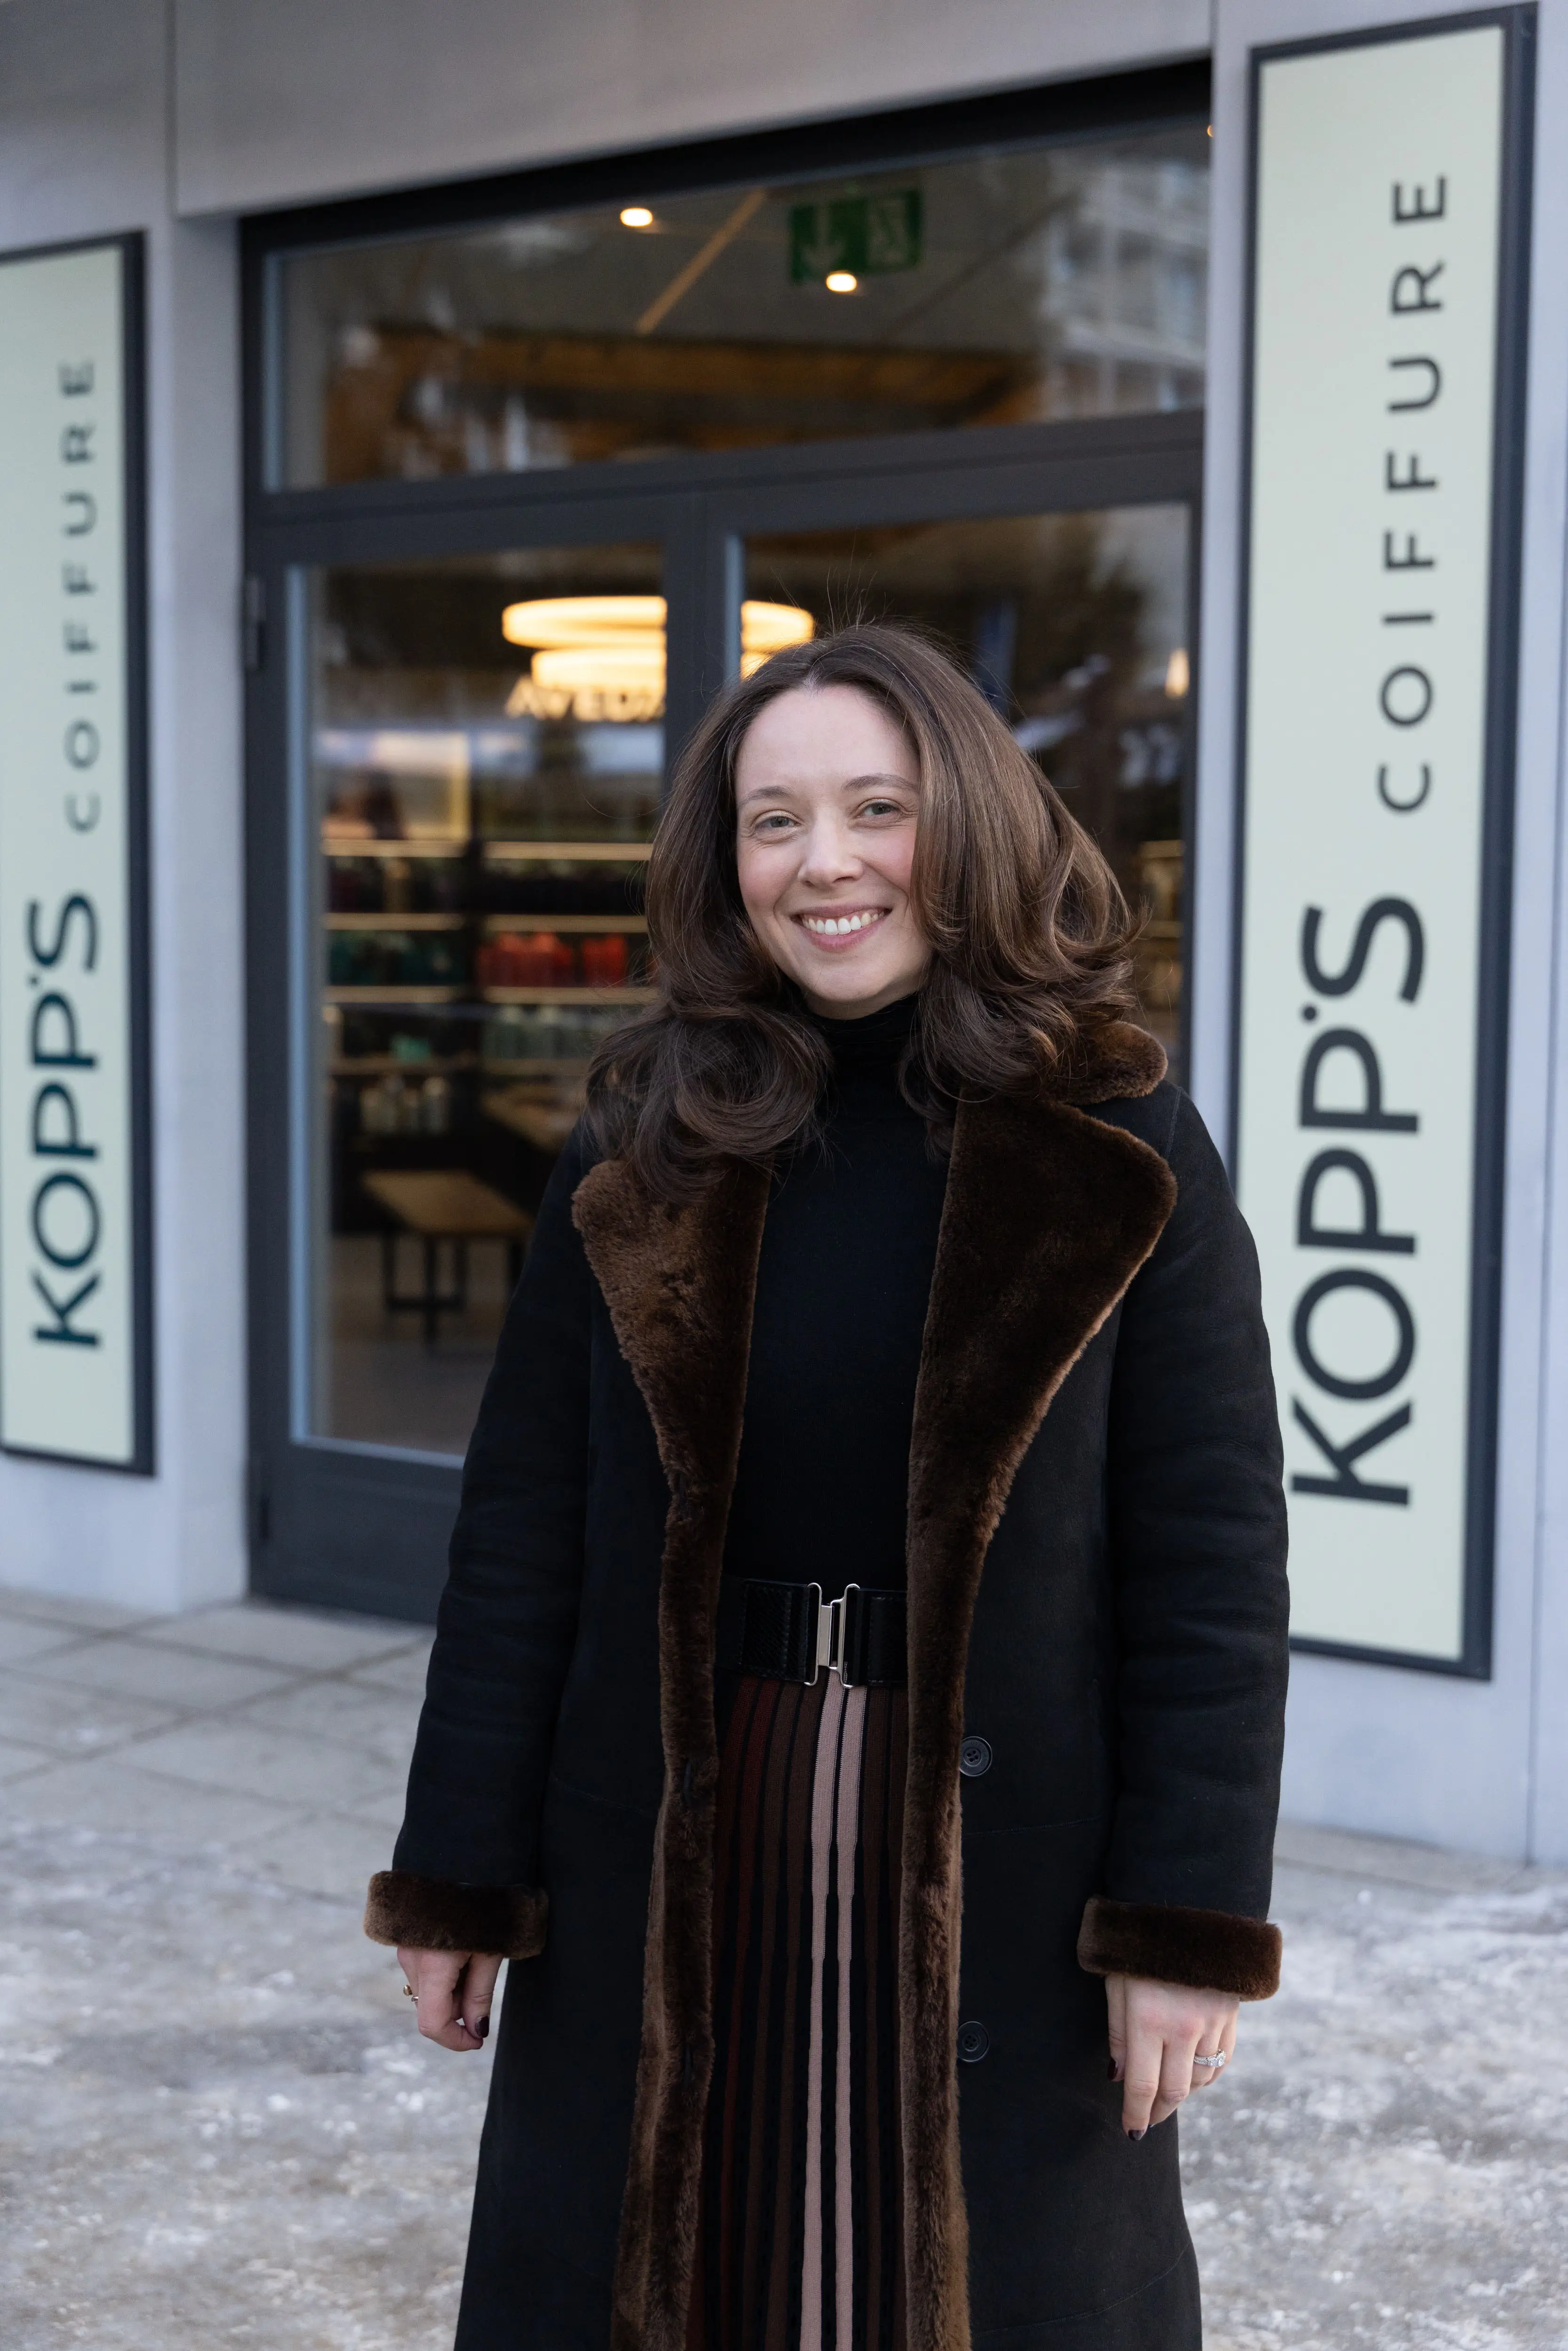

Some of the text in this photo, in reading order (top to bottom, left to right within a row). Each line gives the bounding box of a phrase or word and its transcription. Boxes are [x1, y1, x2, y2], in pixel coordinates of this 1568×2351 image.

[25, 362, 101, 1350] KOPP'S COIFFURE
[1290, 176, 1446, 1507] KOPP'S COIFFURE
